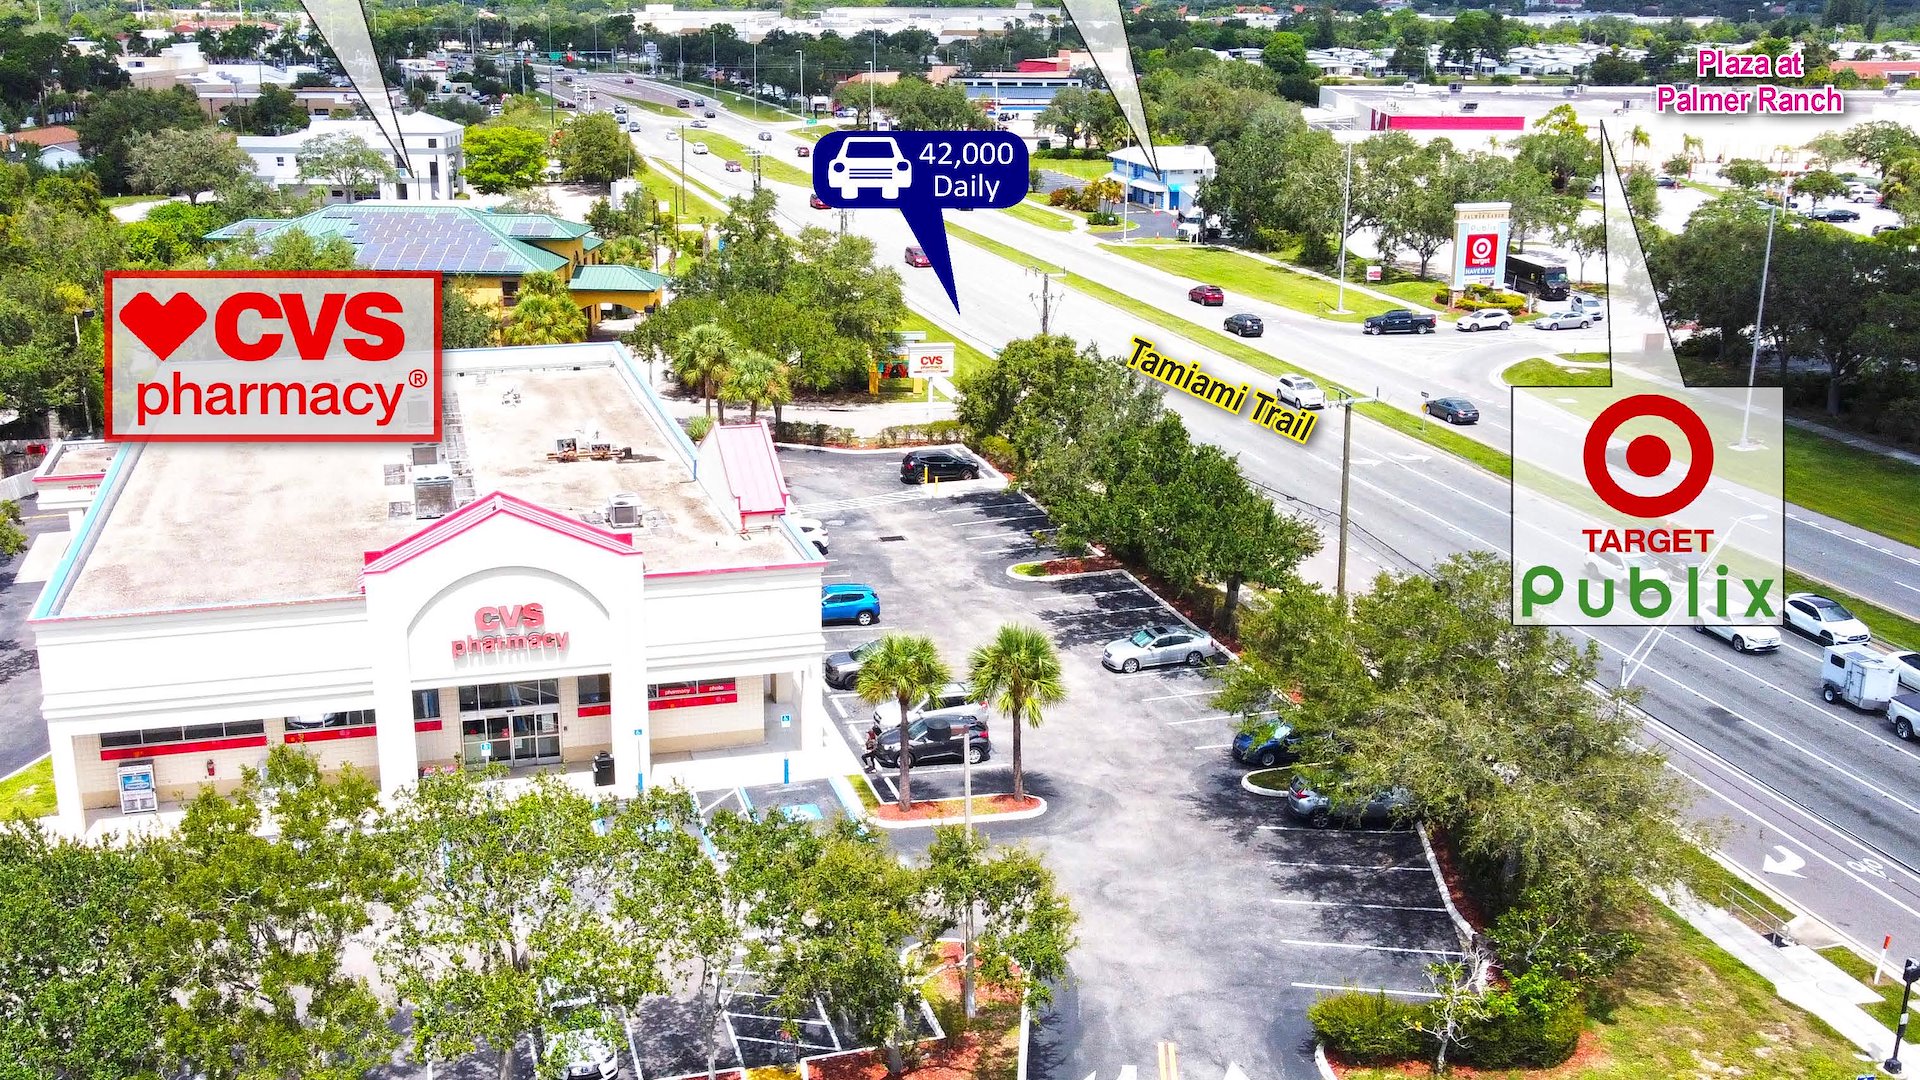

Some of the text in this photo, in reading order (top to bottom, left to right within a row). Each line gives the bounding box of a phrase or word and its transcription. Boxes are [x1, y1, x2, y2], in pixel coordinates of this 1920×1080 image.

[1471, 258, 1491, 266] target
[920, 355, 943, 366] CVS
[474, 602, 545, 632] CVS
[451, 631, 569, 660] pharmacy
[664, 687, 691, 696] pharmacy
